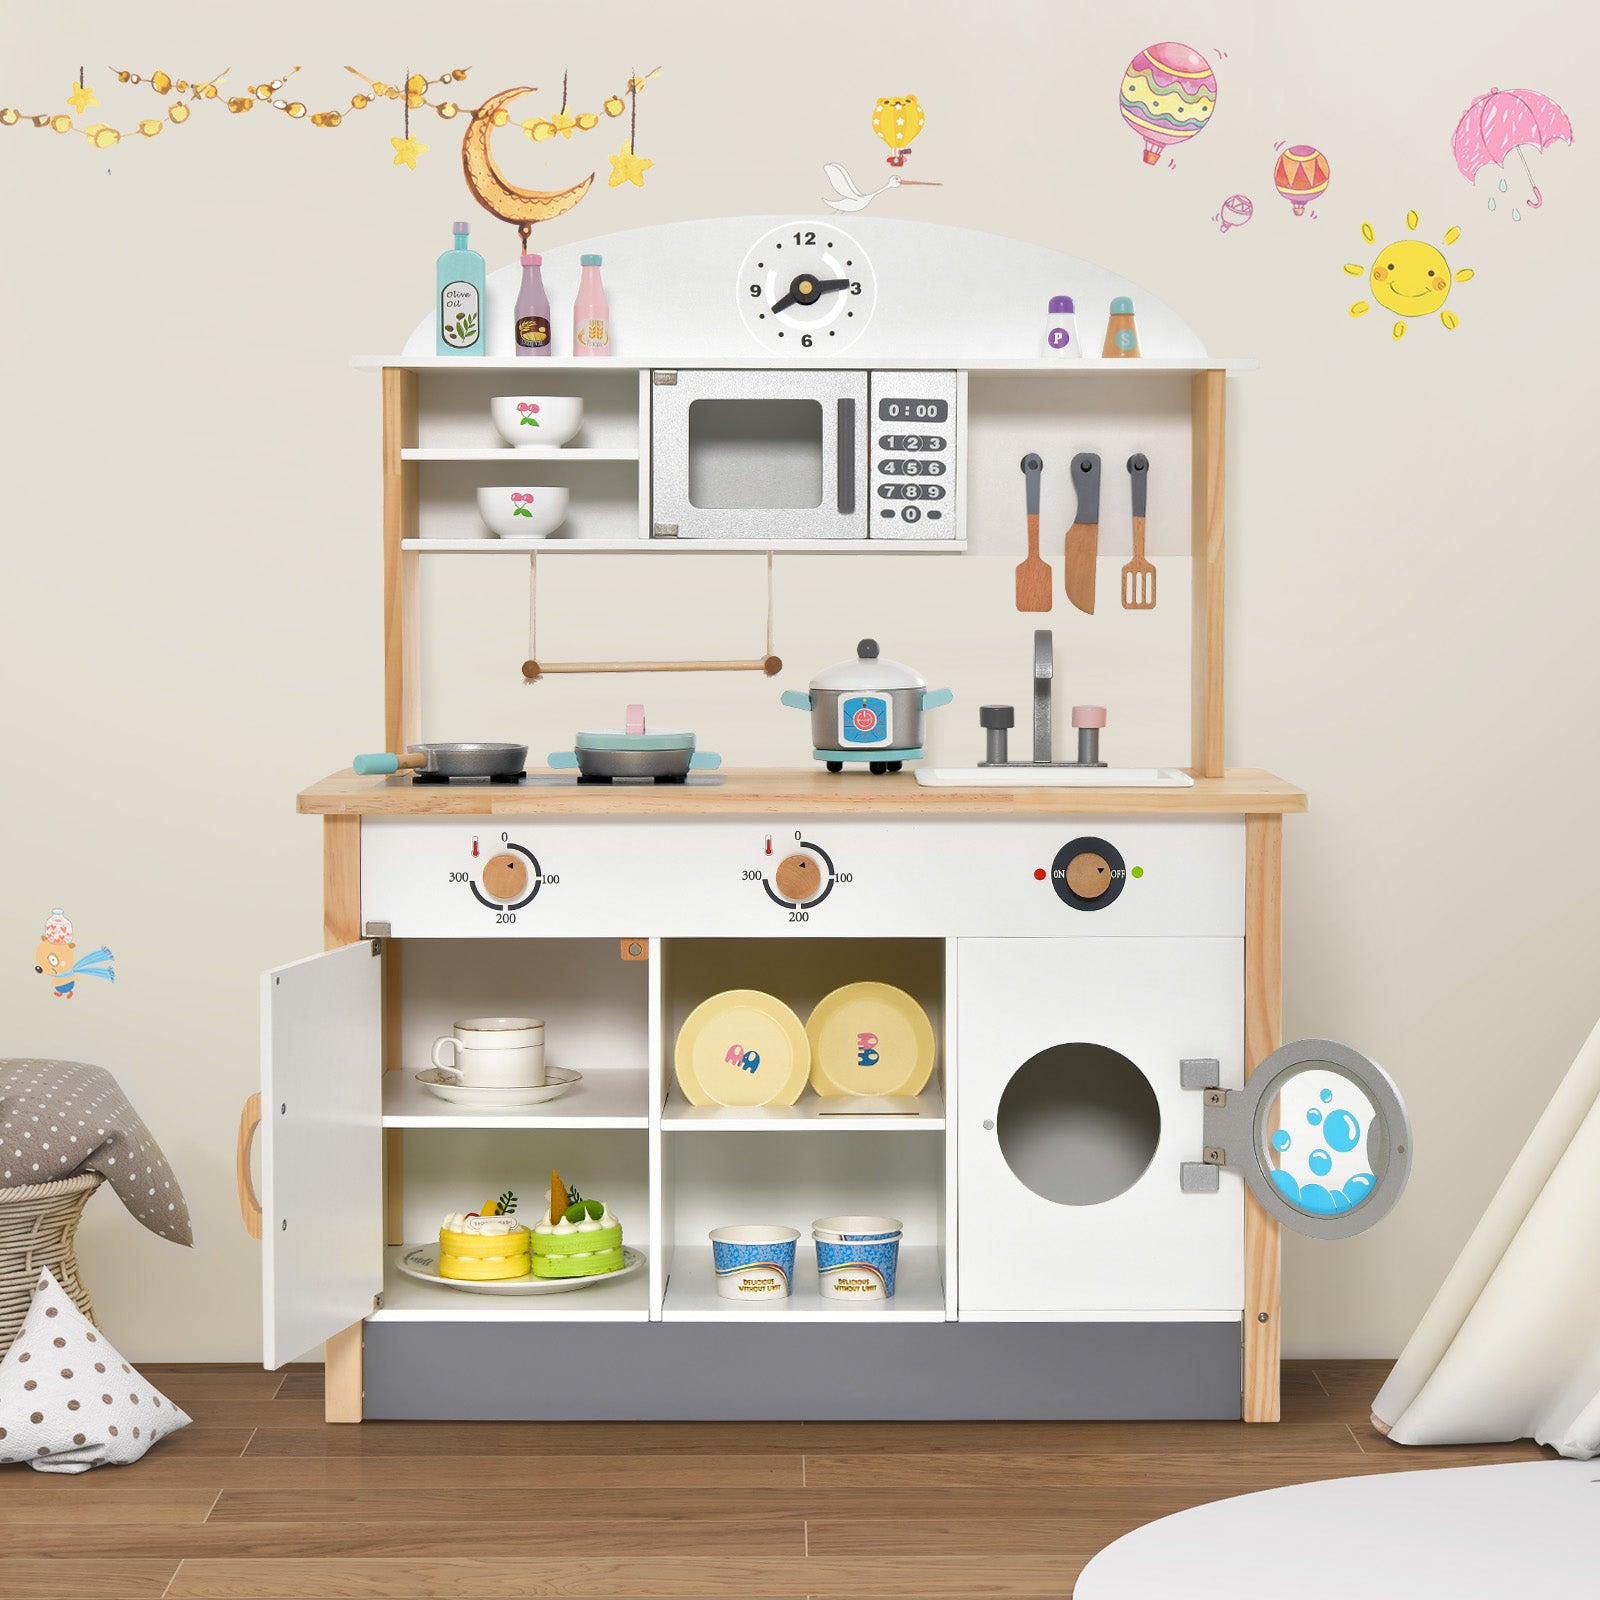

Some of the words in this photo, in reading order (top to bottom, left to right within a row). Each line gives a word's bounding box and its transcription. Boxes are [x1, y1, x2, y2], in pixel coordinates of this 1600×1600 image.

[793, 232, 816, 246] 12
[750, 284, 762, 297] 9
[850, 282, 862, 295] 3
[446, 300, 462, 308] Oil
[801, 334, 813, 347] 6
[1053, 332, 1063, 344] P
[1121, 333, 1130, 346] S
[887, 436, 895, 448] 1
[907, 437, 918, 449] 2
[929, 438, 940, 450] 3
[884, 462, 896, 473] 4
[906, 462, 918, 474] 5
[928, 463, 940, 475] 6
[884, 486, 895, 497] 7
[905, 486, 917, 497] 8
[928, 486, 940, 498] 9
[905, 508, 917, 520] 0
[501, 831, 508, 842] 0
[794, 830, 802, 841] 0
[449, 872, 469, 883] 300
[742, 870, 762, 881] 300
[834, 873, 853, 883] 100
[1053, 869, 1066, 878] ON
[1110, 869, 1126, 878] OFF
[542, 874, 560, 885] 100
[496, 913, 516, 924] 200
[788, 911, 809, 922] 200
[743, 1278, 775, 1286] DELICIOUS
[838, 1278, 870, 1286] DELICIOUS
